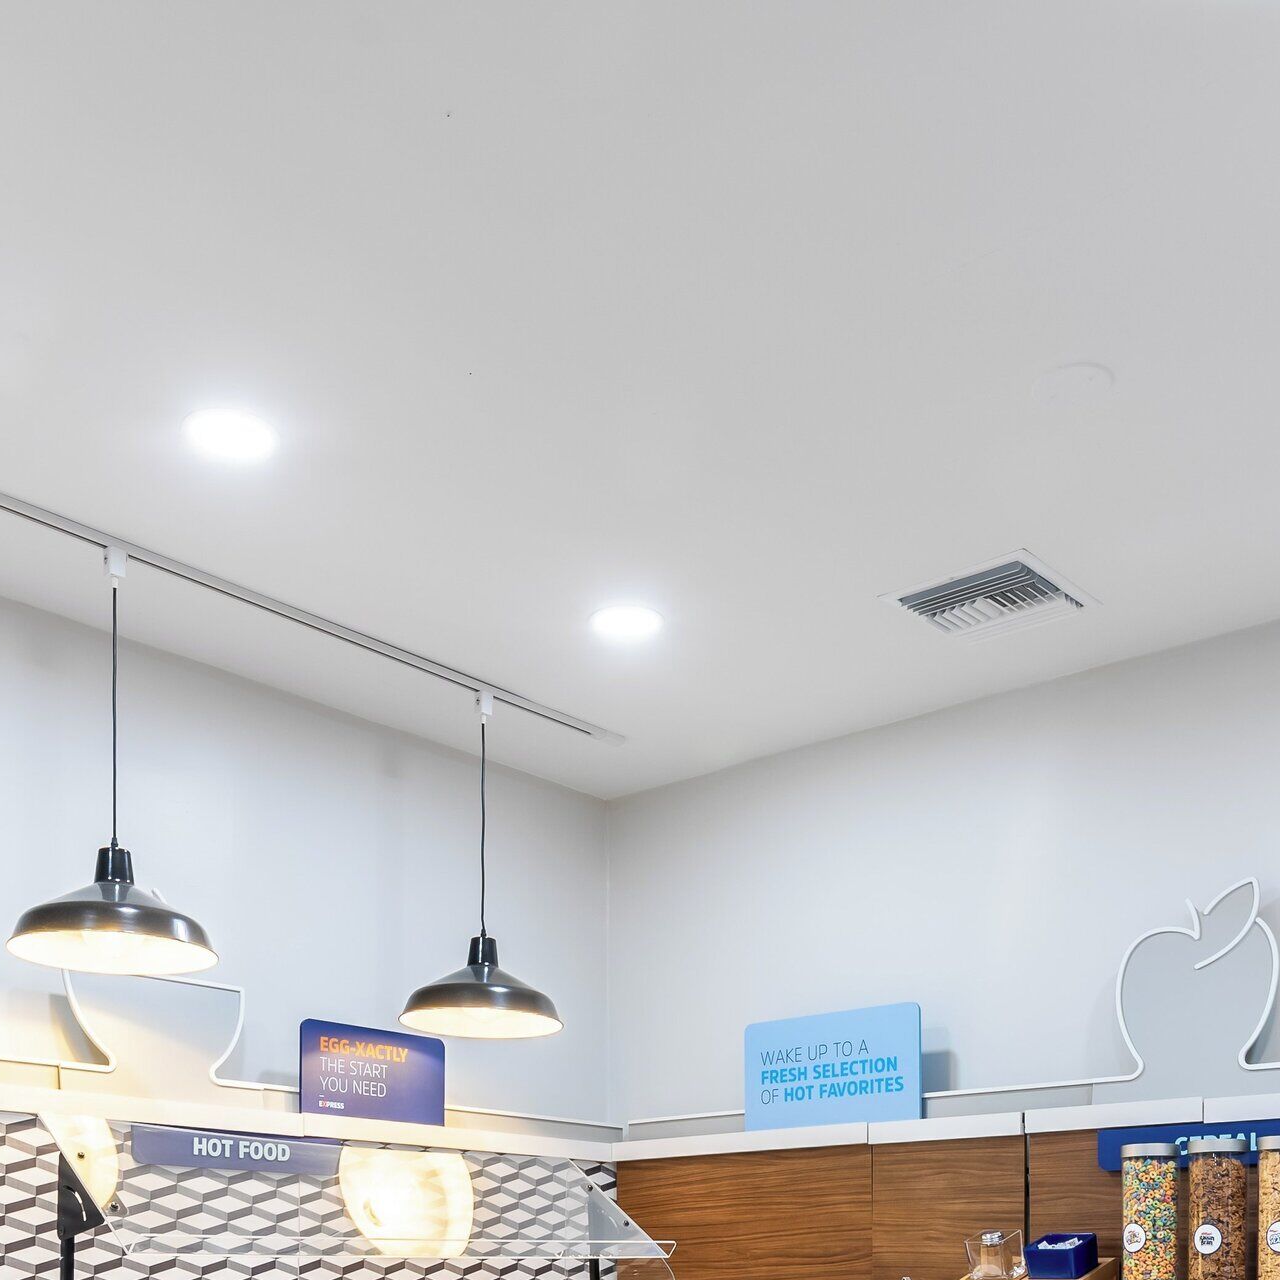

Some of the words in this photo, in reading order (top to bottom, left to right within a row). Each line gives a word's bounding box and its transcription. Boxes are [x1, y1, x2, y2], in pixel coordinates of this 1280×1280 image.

[320, 1036, 408, 1063] EGG-XACTLY
[760, 1047, 802, 1066] WAKE
[808, 1044, 828, 1061] UP
[833, 1041, 853, 1057] TO
[858, 1039, 869, 1055] A
[320, 1056, 345, 1074] THE
[349, 1061, 388, 1079] START
[761, 1066, 808, 1085] FRESH
[813, 1056, 898, 1079] SELECTION
[320, 1076, 348, 1093] YOU
[353, 1080, 387, 1098] NEED
[761, 1088, 779, 1105] OF
[784, 1085, 814, 1102] HOT
[820, 1076, 904, 1099] FAVORITES
[318, 1100, 345, 1110] EXPRESS
[193, 1137, 233, 1158] HOT
[239, 1140, 291, 1161] FOOD
